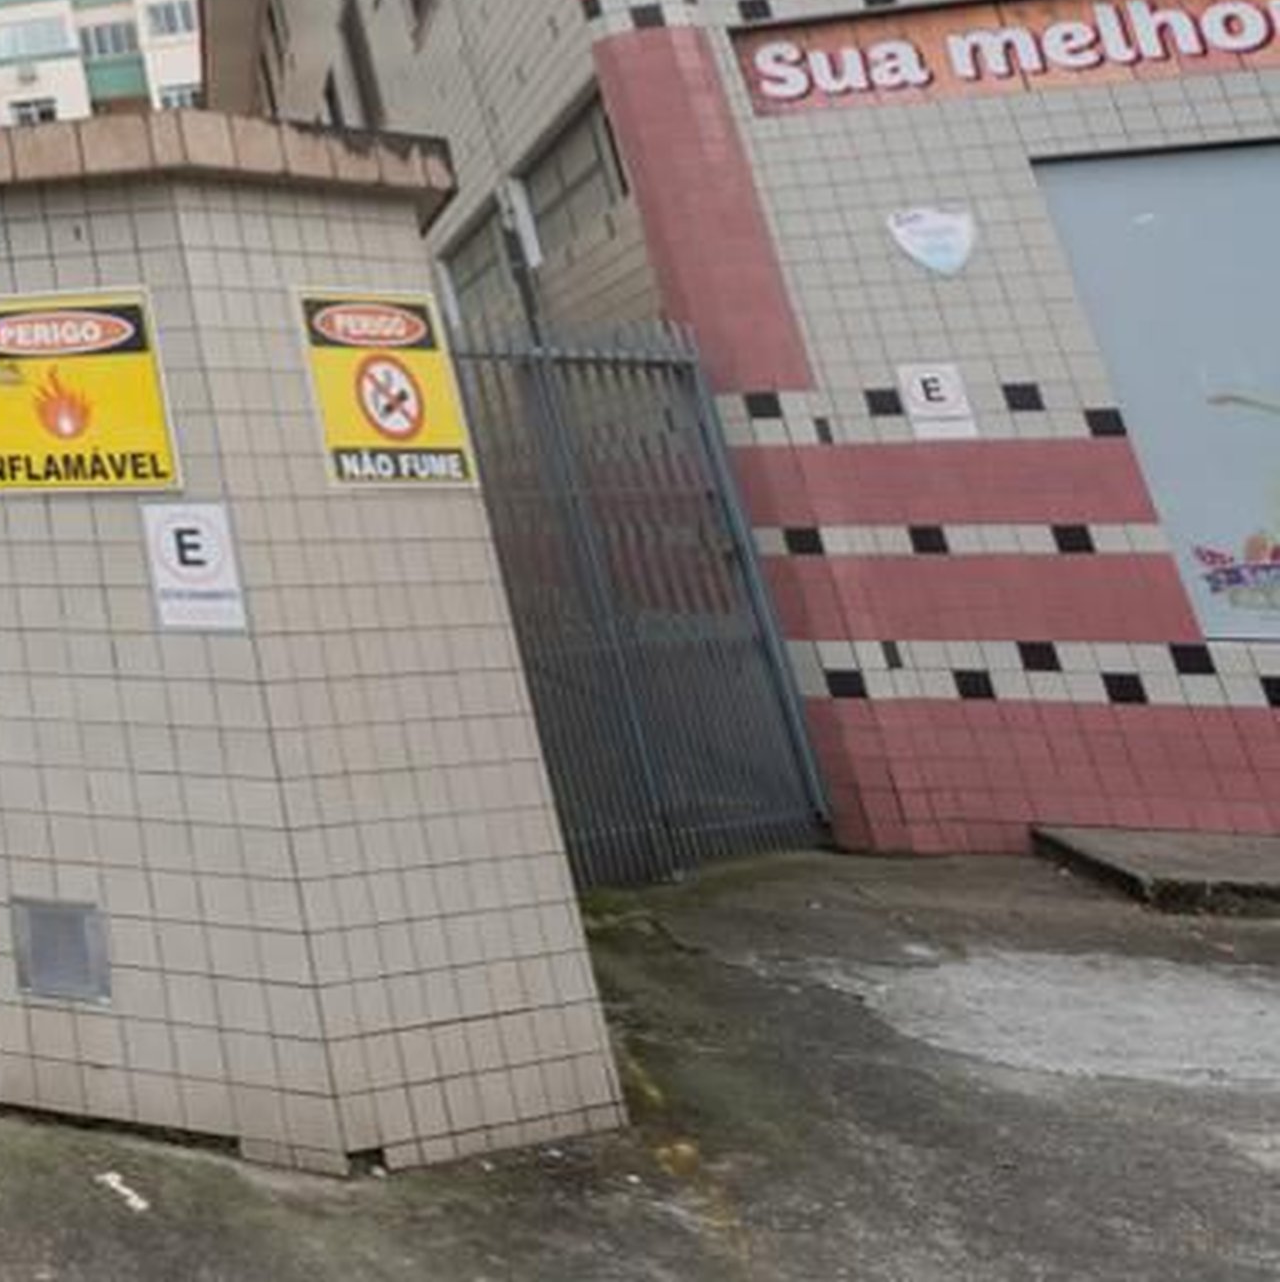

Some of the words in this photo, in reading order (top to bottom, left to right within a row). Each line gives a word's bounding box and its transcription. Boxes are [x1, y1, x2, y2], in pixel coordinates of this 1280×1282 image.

[753, 38, 932, 100] Sua
[0, 320, 102, 346] PERIGO
[334, 313, 408, 338] PERIGO
[920, 377, 946, 402] E
[341, 450, 394, 477] NÃO
[399, 454, 462, 478] FUME
[173, 528, 207, 567] E
